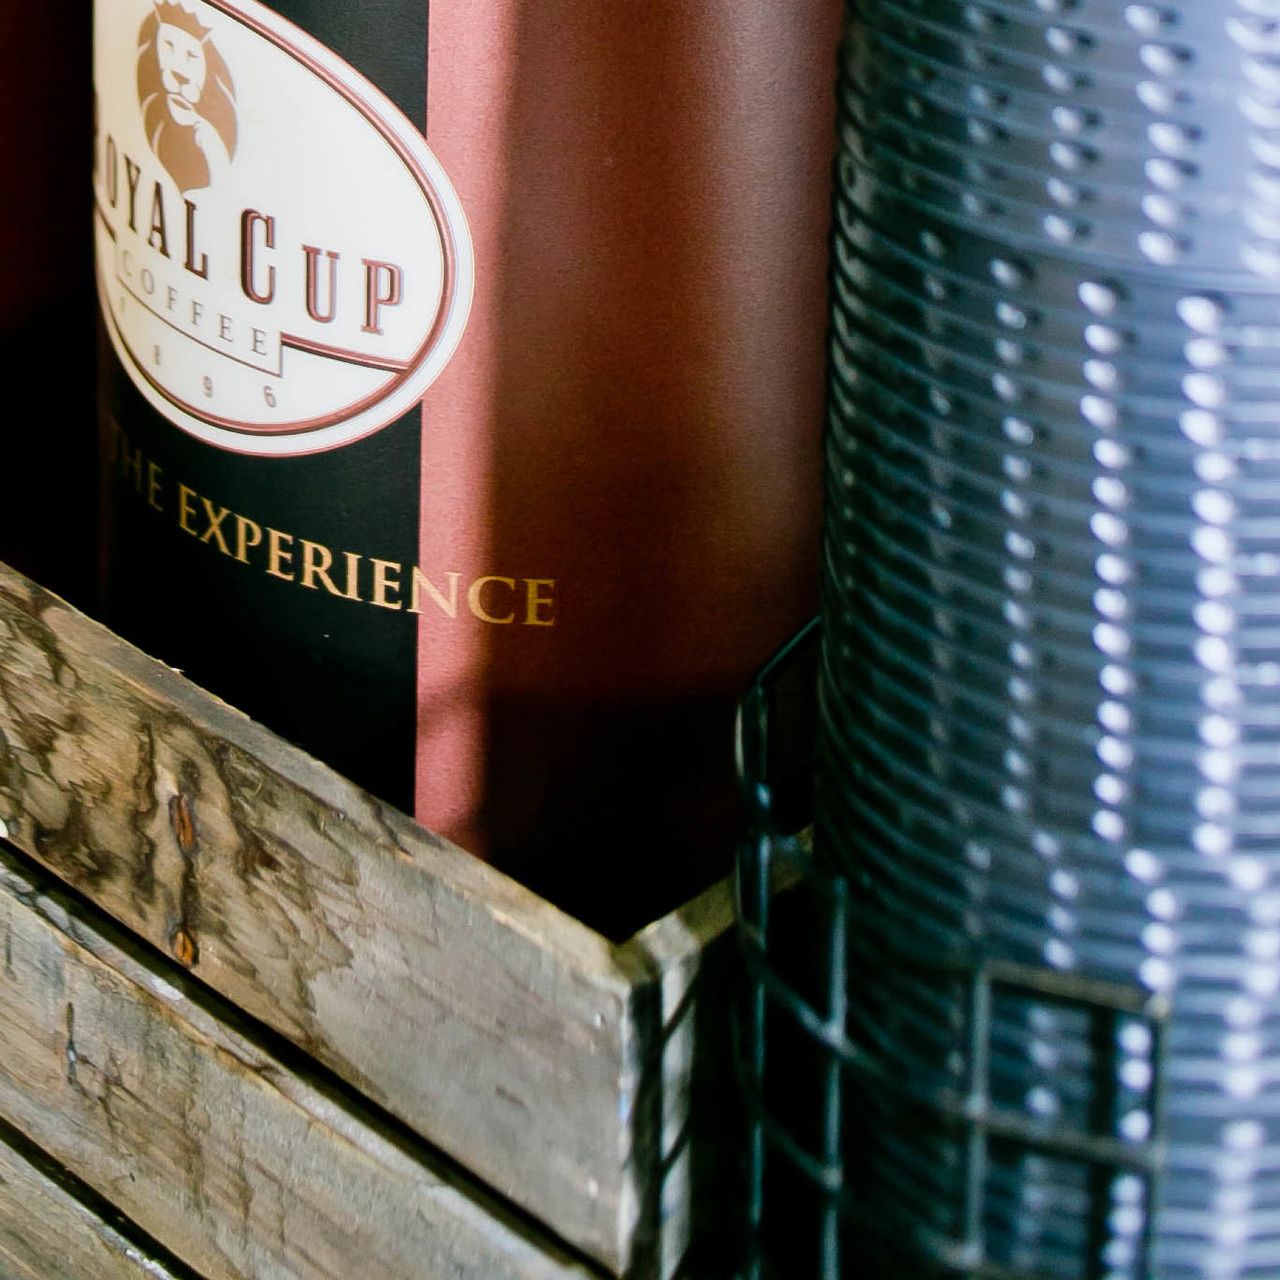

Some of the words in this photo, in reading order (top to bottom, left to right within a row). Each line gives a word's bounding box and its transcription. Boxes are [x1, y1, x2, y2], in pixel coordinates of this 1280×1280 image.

[96, 128, 209, 280] OYAL
[239, 207, 404, 336] CUP
[122, 248, 268, 357] COFFEE
[178, 481, 557, 627] EXPERIENCE
